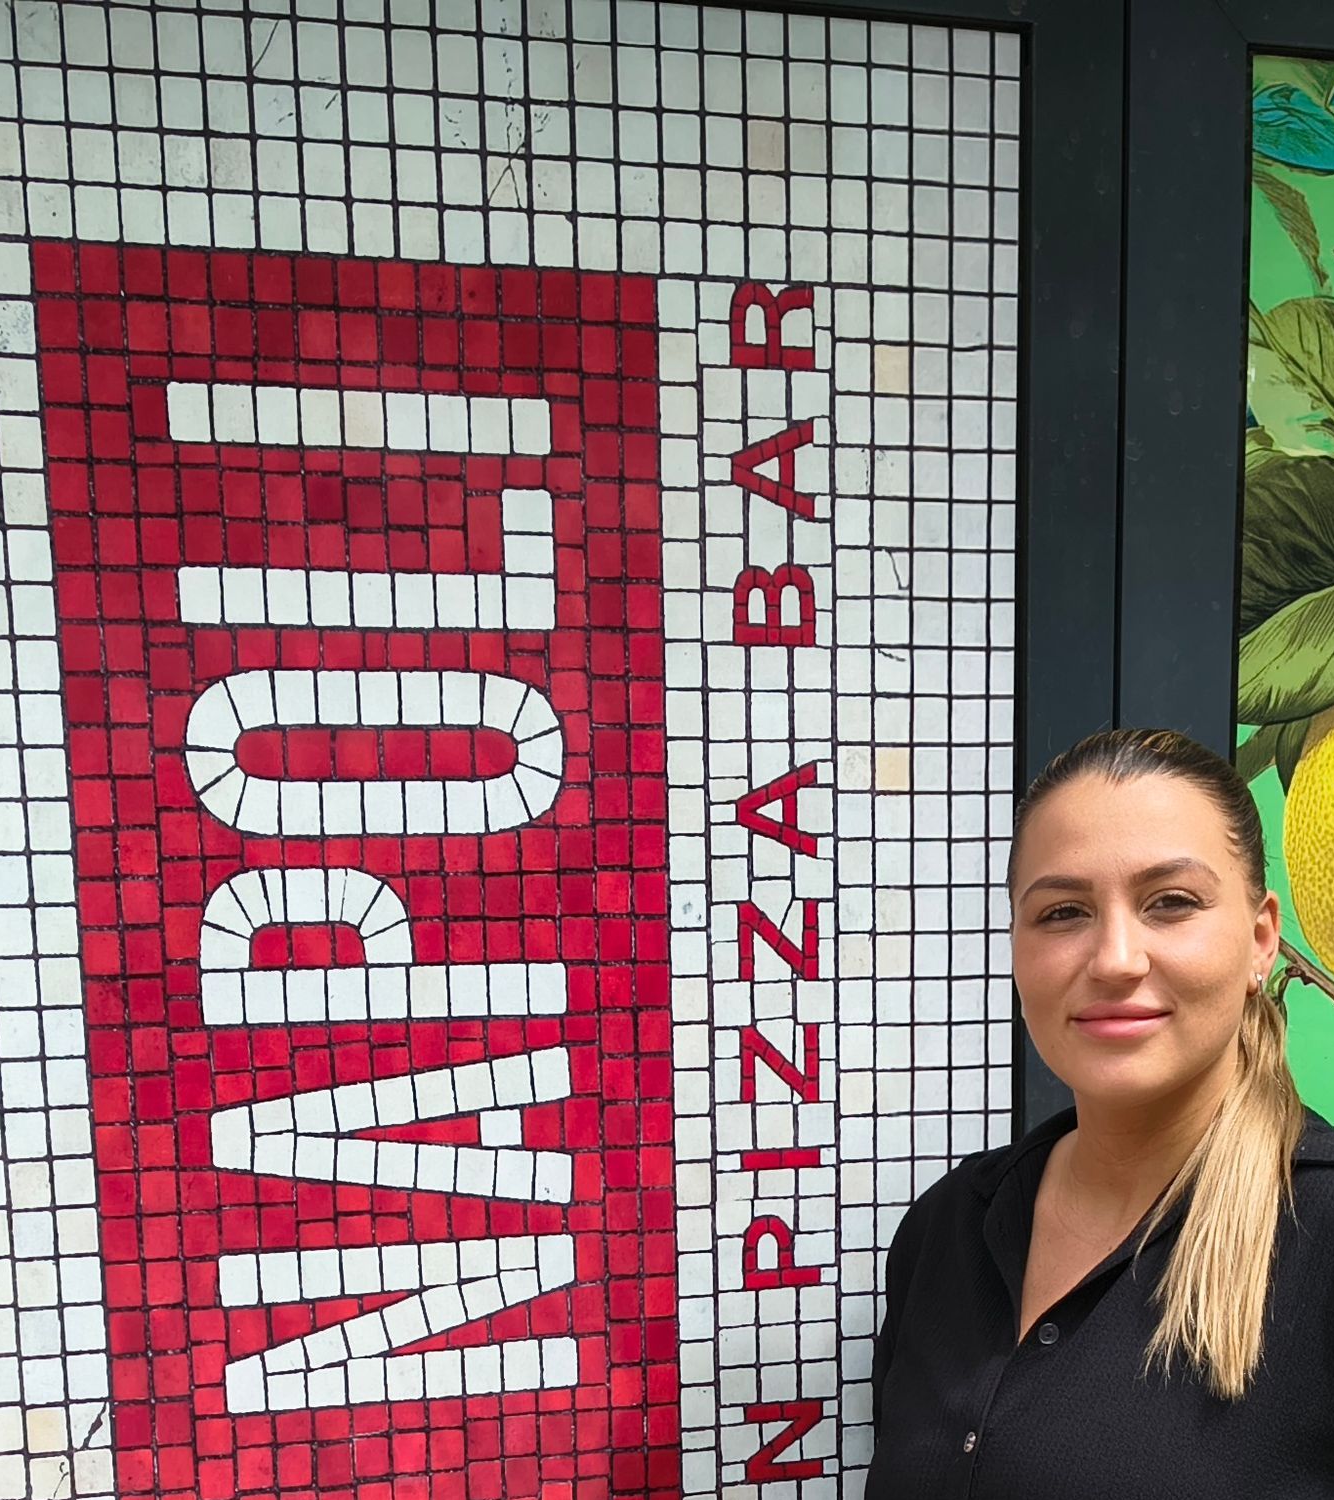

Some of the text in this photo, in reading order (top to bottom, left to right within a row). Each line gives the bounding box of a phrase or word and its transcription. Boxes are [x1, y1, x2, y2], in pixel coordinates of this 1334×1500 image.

[731, 283, 815, 647] BAR
[167, 382, 575, 1413] NAPOLI
[737, 761, 821, 1290] PIZZA
